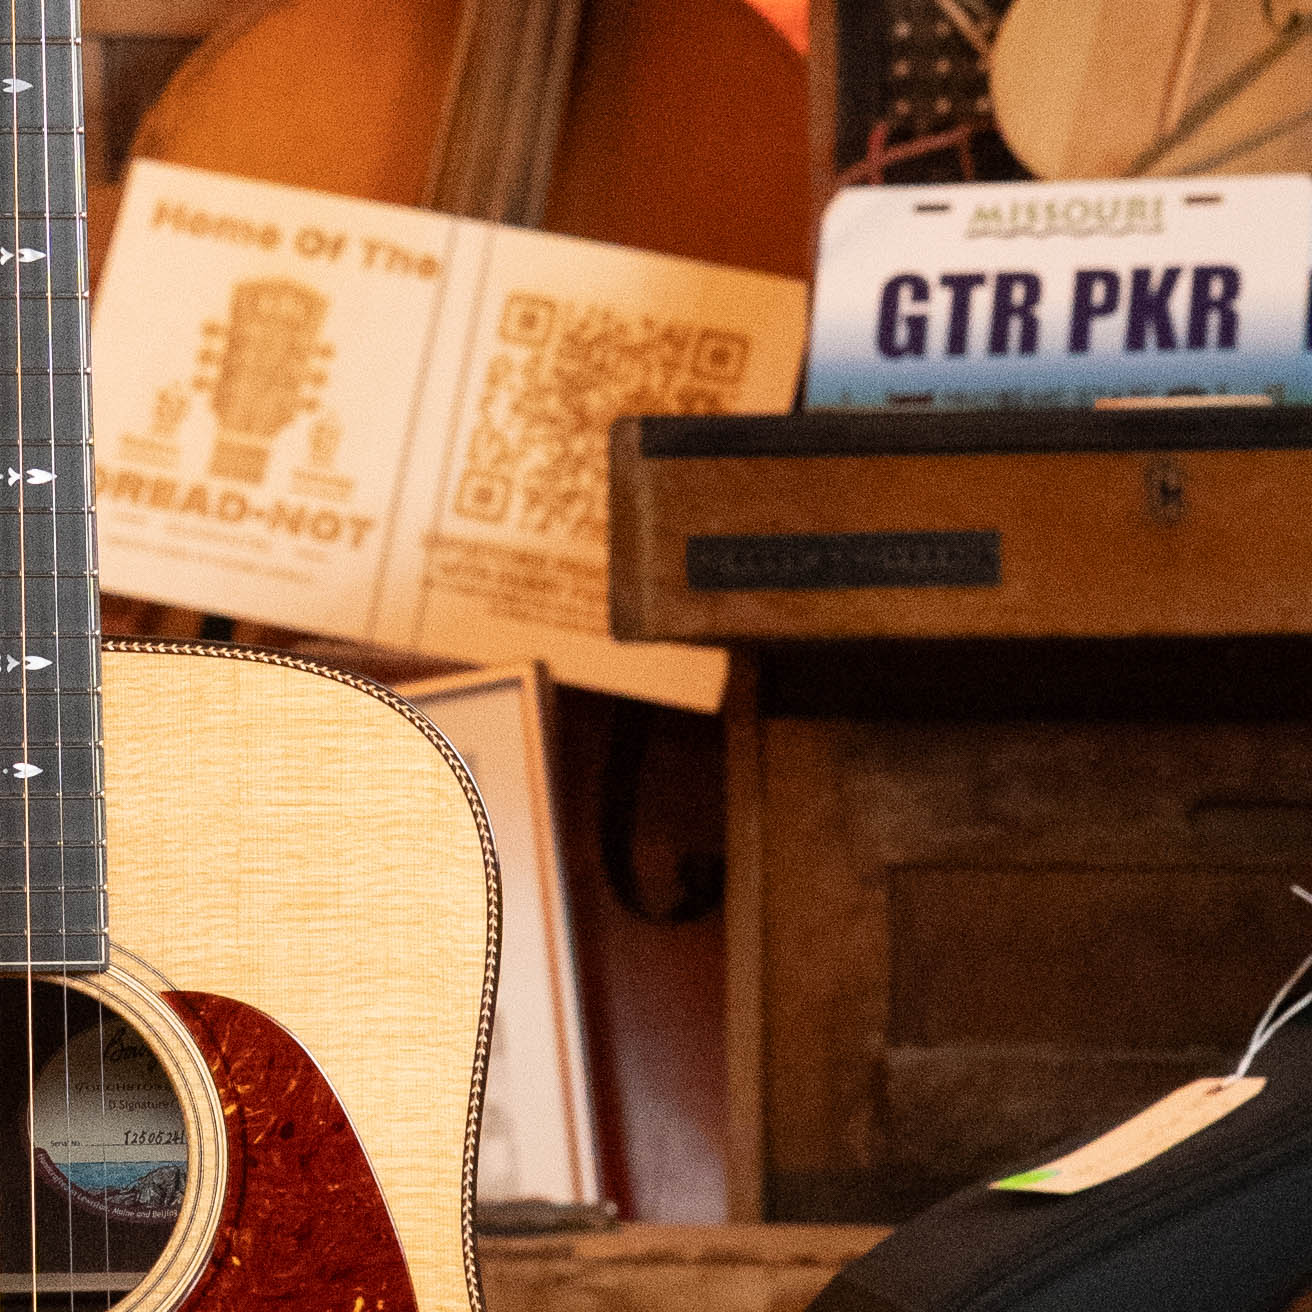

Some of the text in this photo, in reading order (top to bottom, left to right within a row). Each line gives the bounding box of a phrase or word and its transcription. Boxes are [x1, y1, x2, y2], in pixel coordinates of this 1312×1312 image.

[150, 199, 443, 281] Home Of The
[971, 195, 1166, 226] MISSOURI
[877, 270, 1042, 359] GTR
[1069, 264, 1242, 354] PKR
